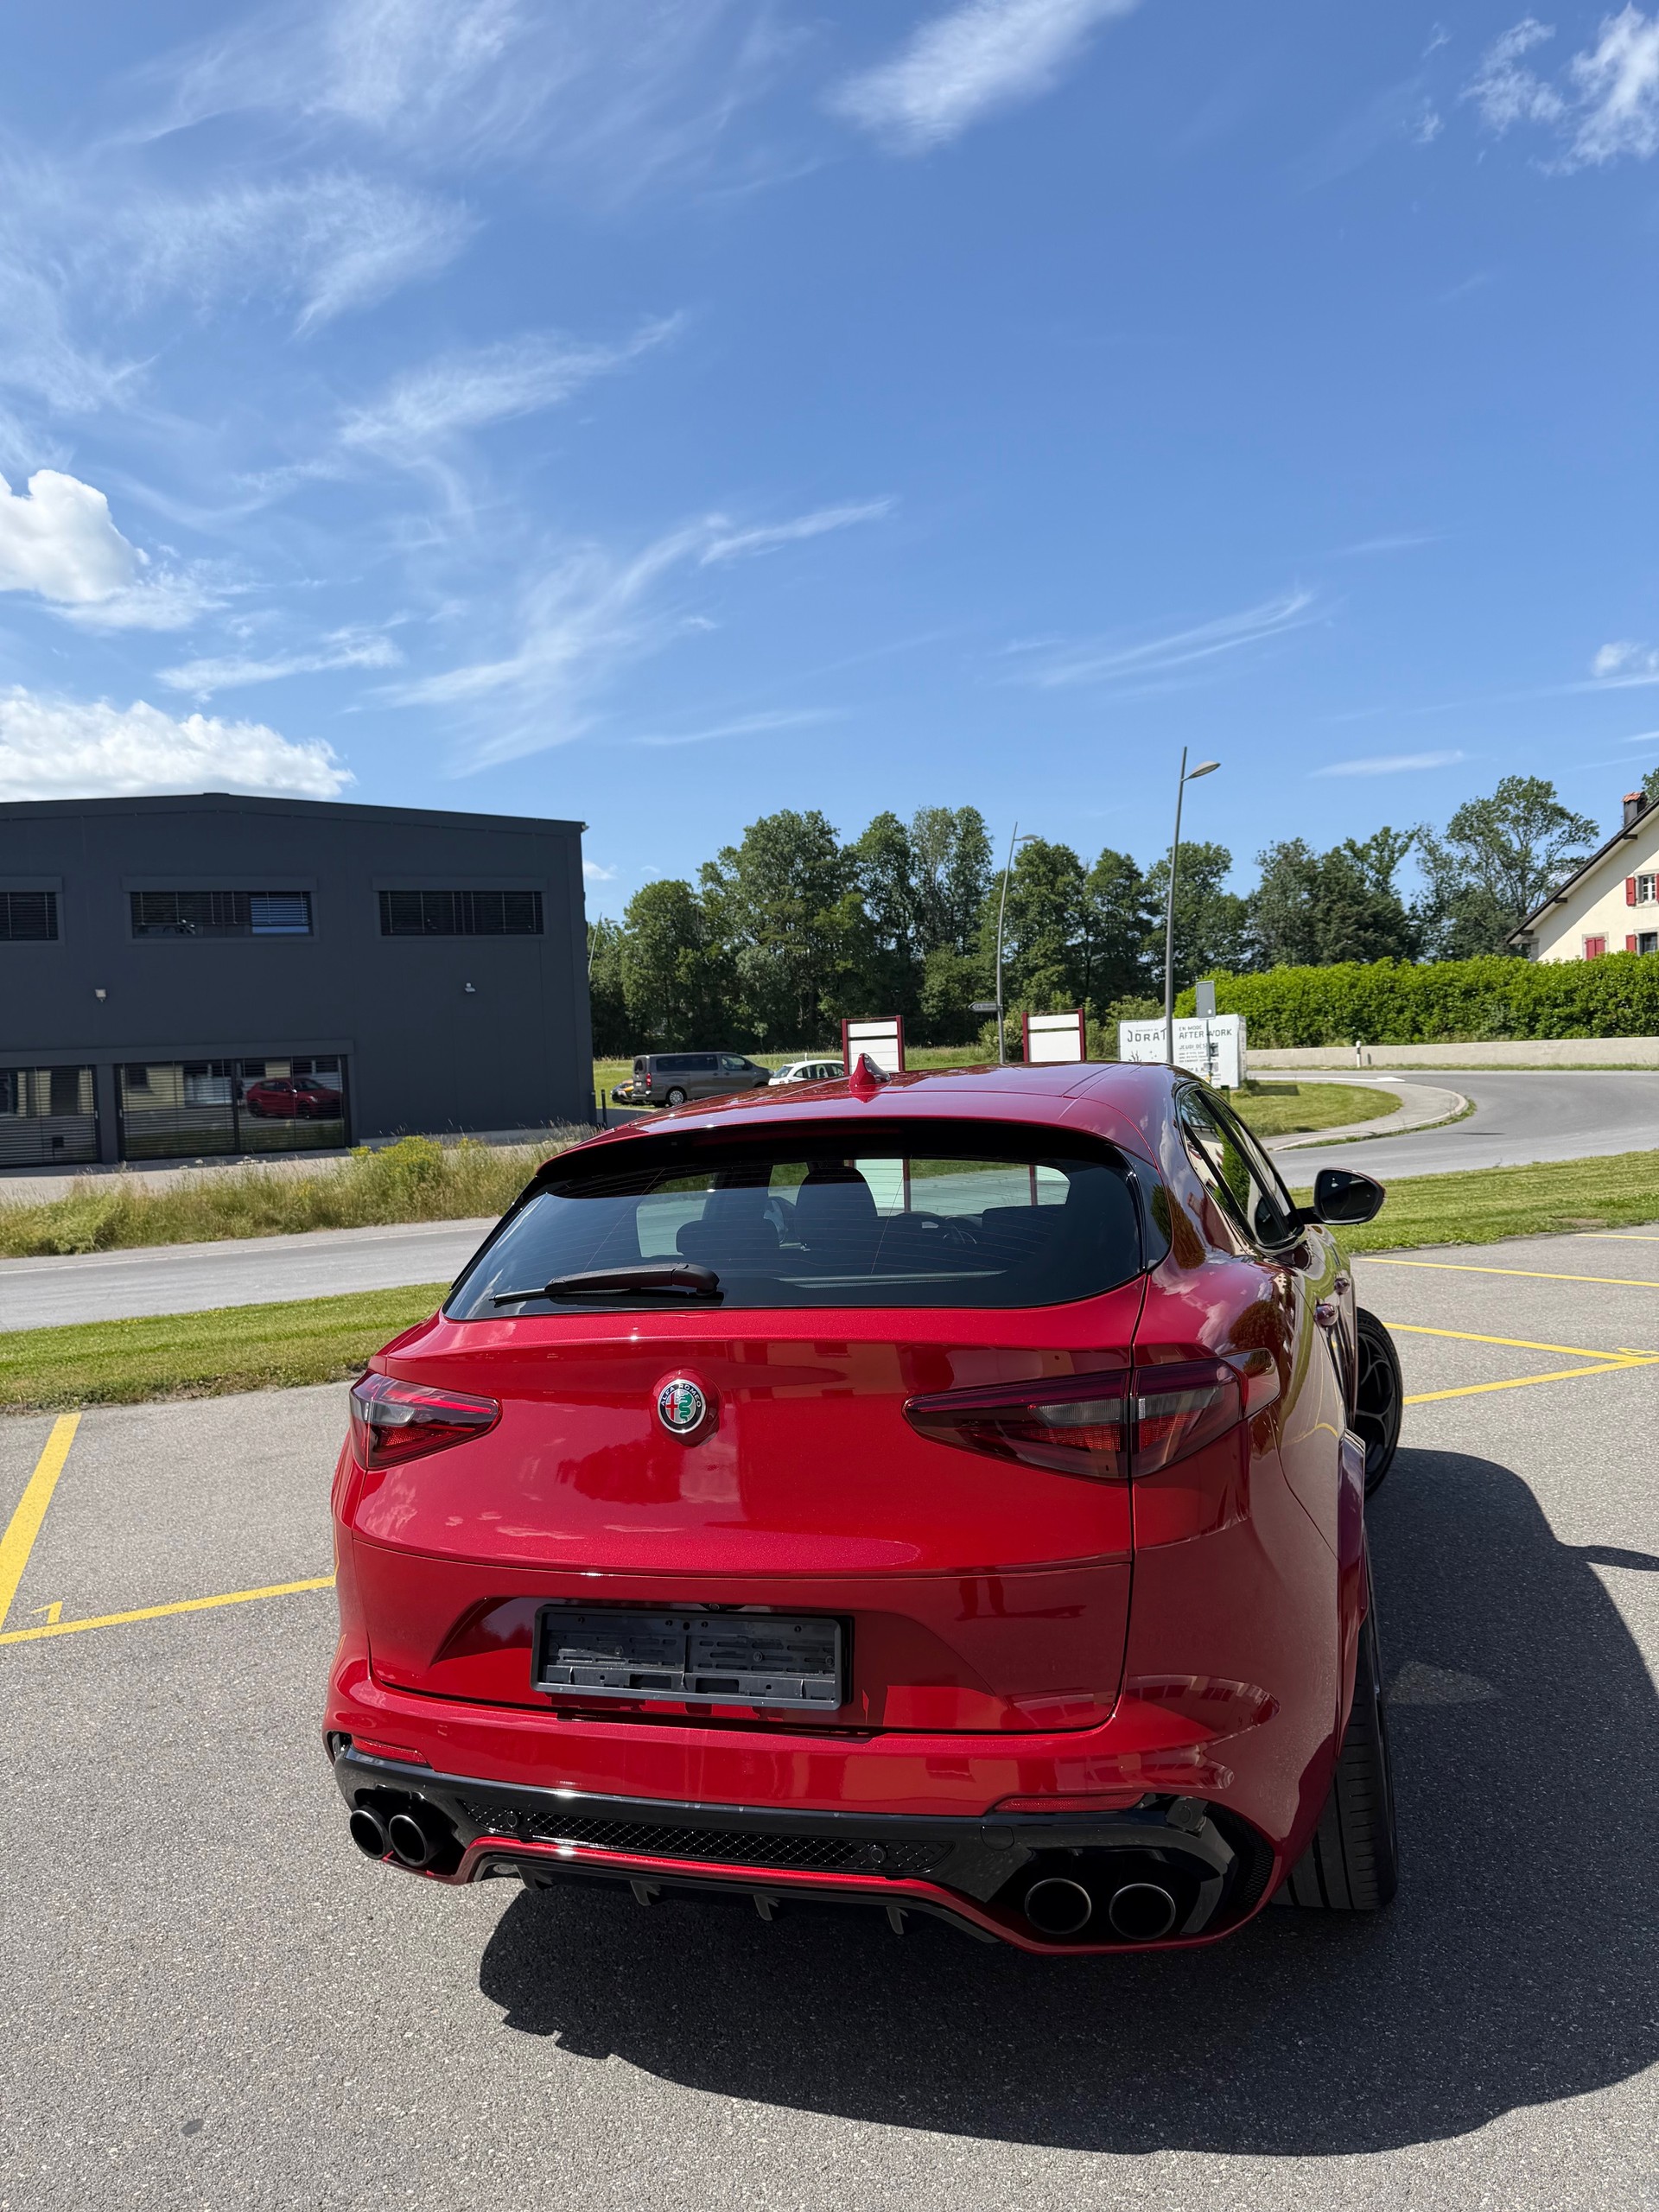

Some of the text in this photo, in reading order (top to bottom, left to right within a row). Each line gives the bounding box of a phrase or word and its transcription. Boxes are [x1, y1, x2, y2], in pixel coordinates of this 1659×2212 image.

[1127, 1027, 1166, 1043] JORAT
[1179, 1031, 1205, 1039] AFTER
[660, 1383, 702, 1408] ALFA ROMEO
